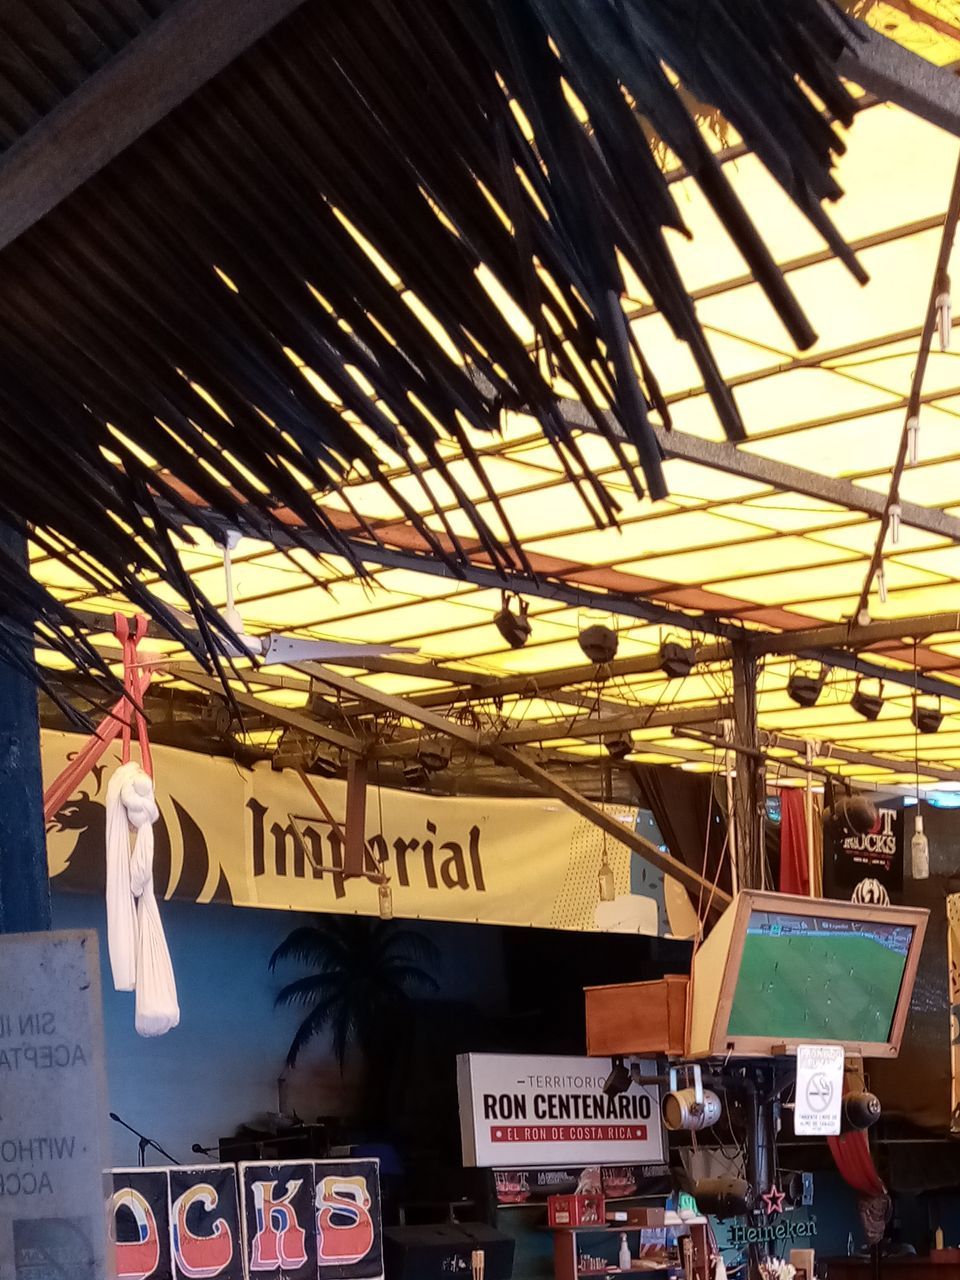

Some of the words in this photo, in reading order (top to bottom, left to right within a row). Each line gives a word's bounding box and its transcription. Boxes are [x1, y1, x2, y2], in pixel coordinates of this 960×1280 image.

[528, 1075, 606, 1089] TERRITORIO
[483, 1094, 527, 1119] RON
[534, 1094, 651, 1119] CENTENARIO
[507, 1128, 519, 1141] EL
[525, 1128, 546, 1140] RON
[551, 1127, 564, 1140] DE
[569, 1127, 602, 1140] COSTA
[608, 1127, 632, 1139] RICA
[733, 1219, 818, 1244] Heineken
